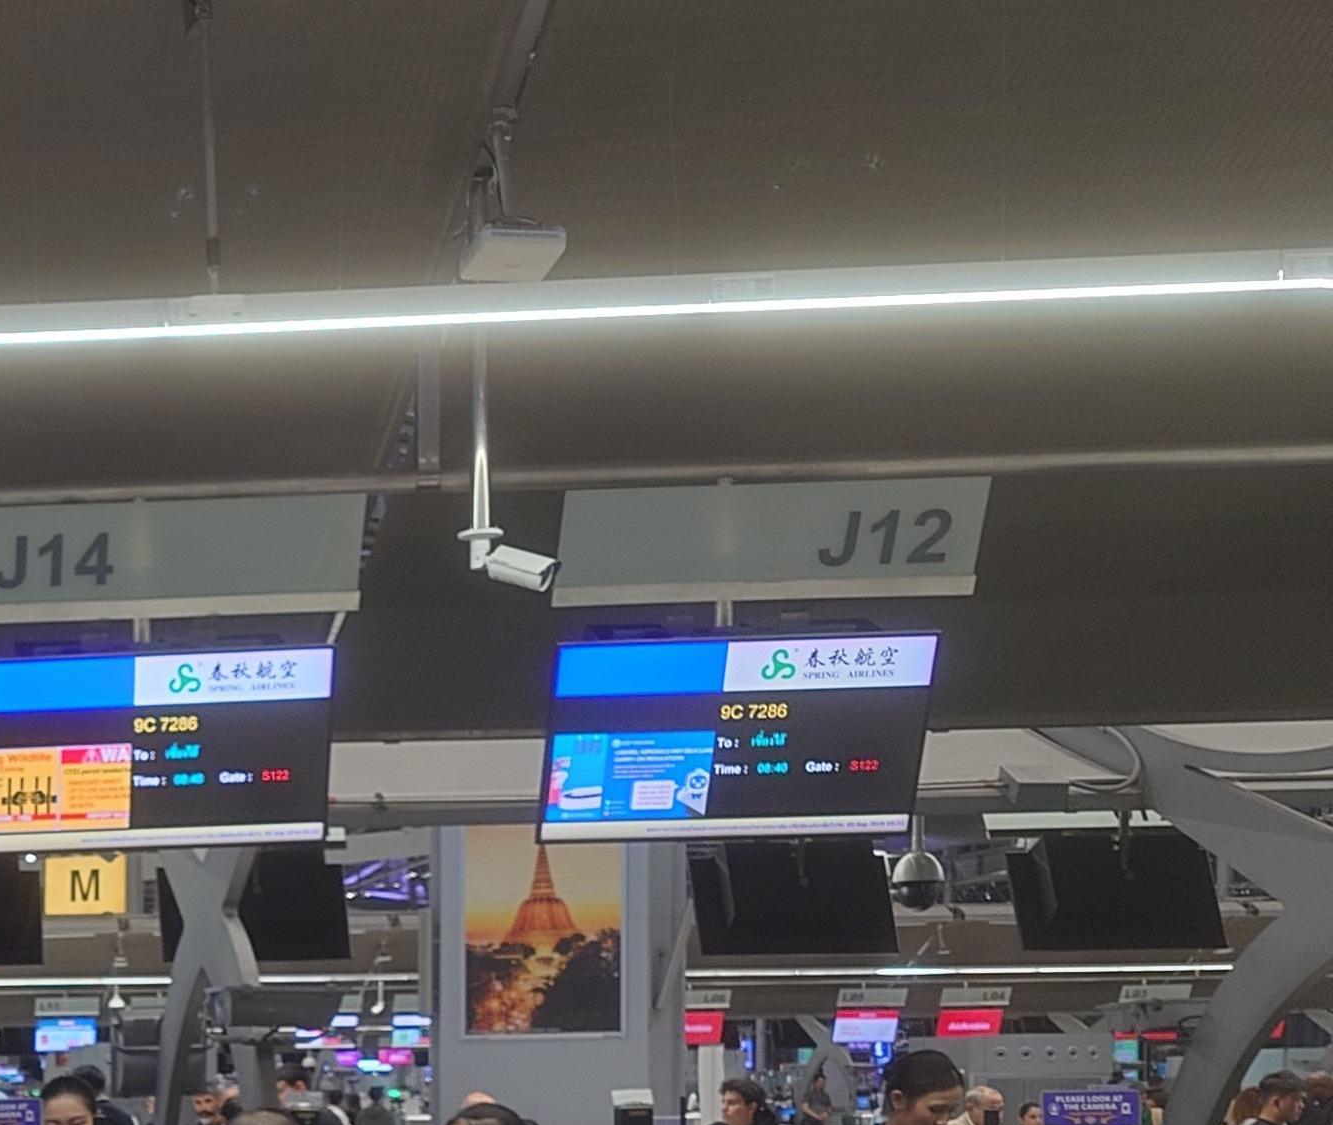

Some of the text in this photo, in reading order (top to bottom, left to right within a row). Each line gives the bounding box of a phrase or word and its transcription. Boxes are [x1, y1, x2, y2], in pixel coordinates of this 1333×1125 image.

[818, 508, 953, 567] J12
[804, 647, 899, 668] 春秋航空
[209, 660, 298, 681] 春秋航空
[803, 669, 894, 680] SPRING AIRLINES
[720, 703, 788, 720] 9C 7286
[160, 715, 199, 732] 7286
[70, 869, 100, 901] M
[1055, 1094, 1124, 1104] PLEASE LOOK AT
[1063, 1102, 1118, 1111] THE CAMERA
